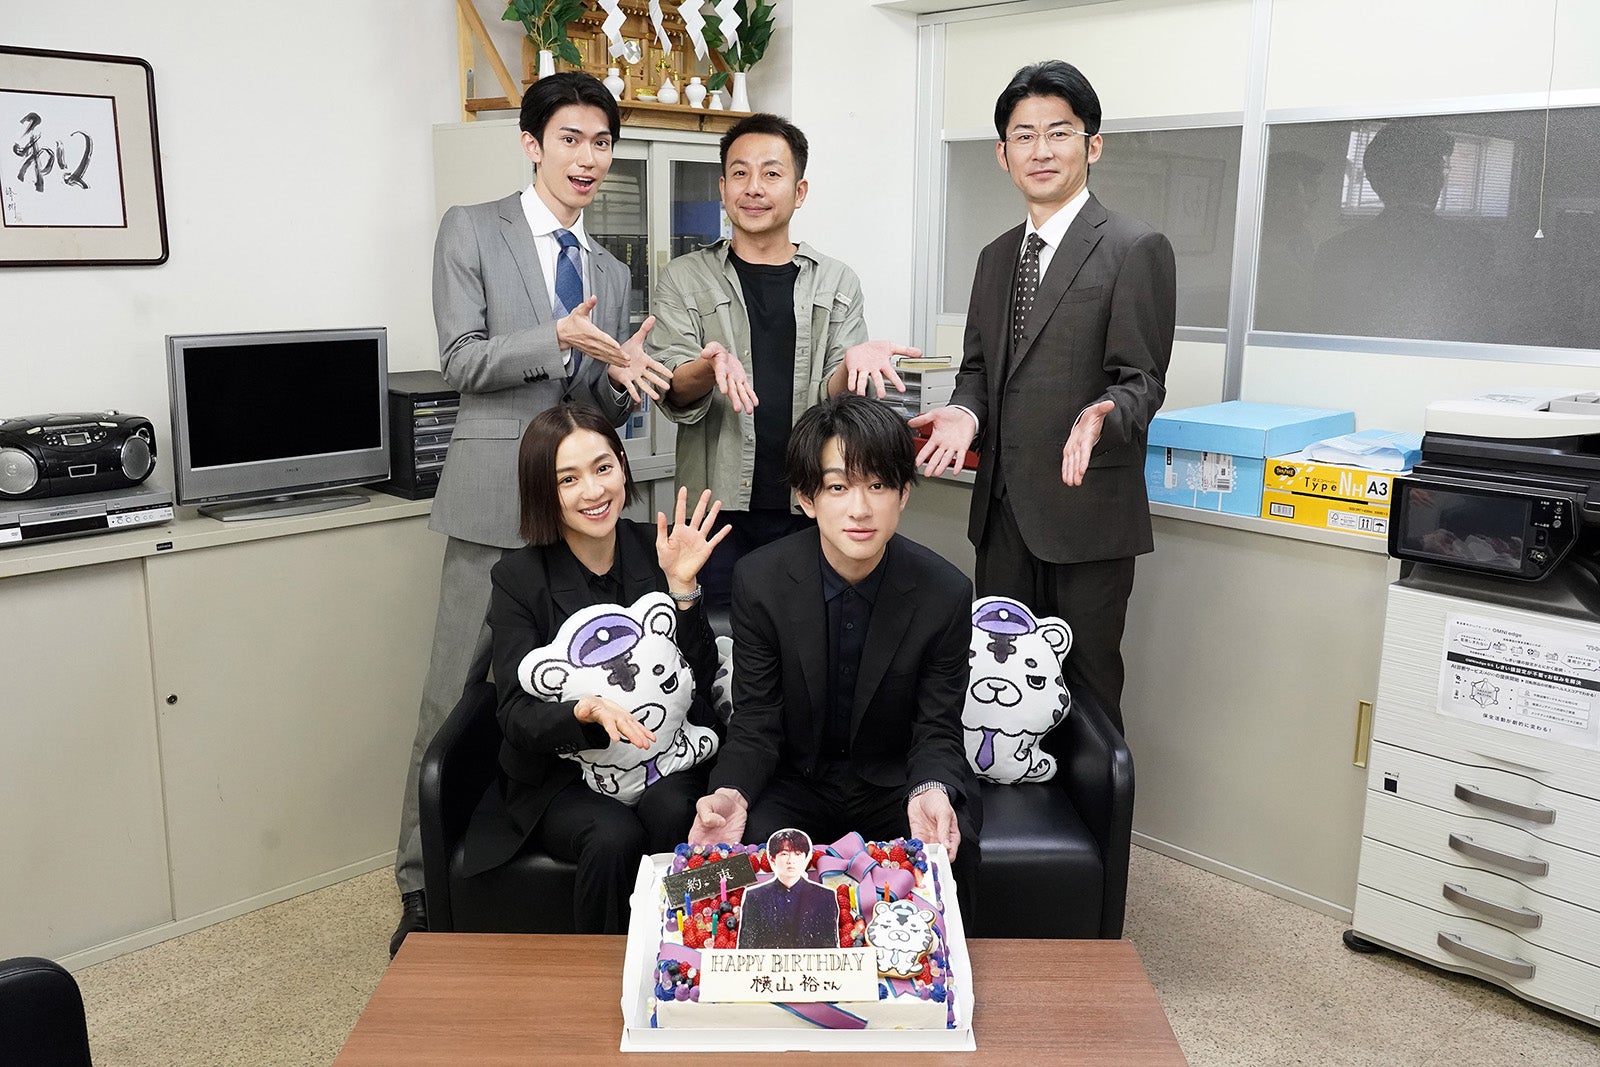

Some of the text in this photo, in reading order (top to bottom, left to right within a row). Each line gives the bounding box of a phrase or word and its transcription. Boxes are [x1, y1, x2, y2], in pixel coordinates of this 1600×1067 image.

[1304, 471, 1388, 498] Type NH A3
[711, 952, 865, 973] HAPPY BIRTHDAY
